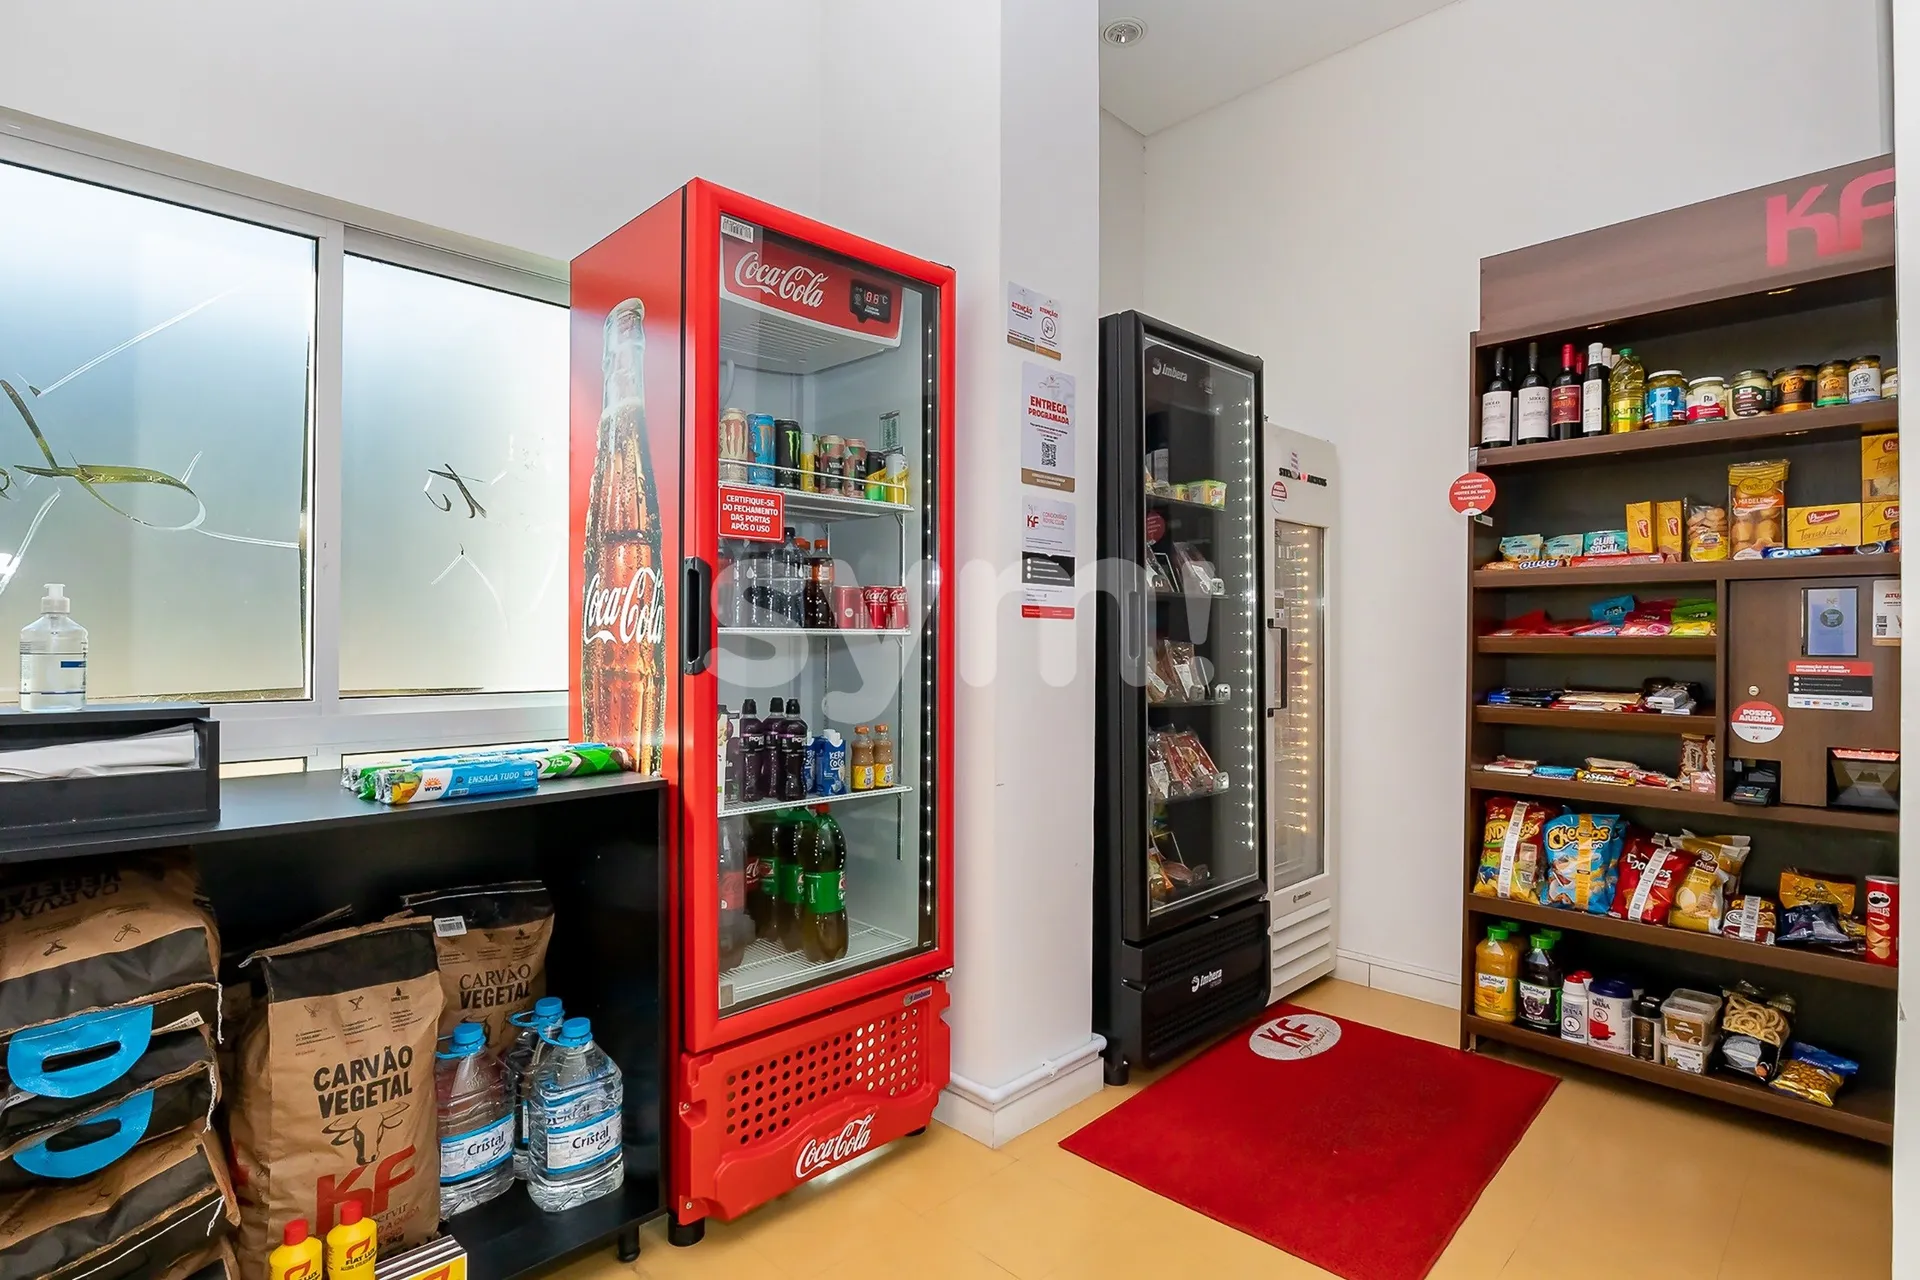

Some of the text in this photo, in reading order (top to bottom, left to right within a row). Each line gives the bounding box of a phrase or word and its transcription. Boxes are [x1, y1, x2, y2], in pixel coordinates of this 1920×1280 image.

[1766, 167, 1896, 267] KF
[735, 252, 829, 308] Coca-Cola
[1162, 363, 1188, 382] Imbera
[1030, 395, 1067, 415] ENTREGA
[1028, 407, 1070, 425] PROGRAMADA
[722, 503, 779, 516] DO FECHAMENTO
[726, 495, 775, 506] CERTIFIQUE-SE
[730, 513, 771, 524] DAS PORTAS
[731, 521, 749, 531] APÓS
[756, 525, 770, 533] USO
[1027, 514, 1039, 528] KF
[1589, 543, 1619, 553] SOCIAL
[1593, 535, 1615, 545] CLUB
[583, 566, 664, 645] Coca-Cola
[1738, 714, 1776, 723] AJUDAR?
[1743, 709, 1772, 717] POSSO
[468, 774, 498, 784] ENSACA
[500, 771, 520, 780] TUDO
[1547, 824, 1611, 851] Cheos
[1627, 853, 1672, 878] DOOS
[1695, 859, 1715, 872] Chips
[459, 963, 532, 990] CARVÃO
[460, 980, 531, 1010] VEGETAL
[1258, 1018, 1316, 1049] KF
[313, 1045, 413, 1092] CARVÃO
[318, 1071, 413, 1119] VEGETAL
[467, 1131, 505, 1156] Cristal
[572, 1127, 610, 1150] Cristal
[795, 1113, 876, 1178] Coca-Cola
[315, 1144, 417, 1237] KF
